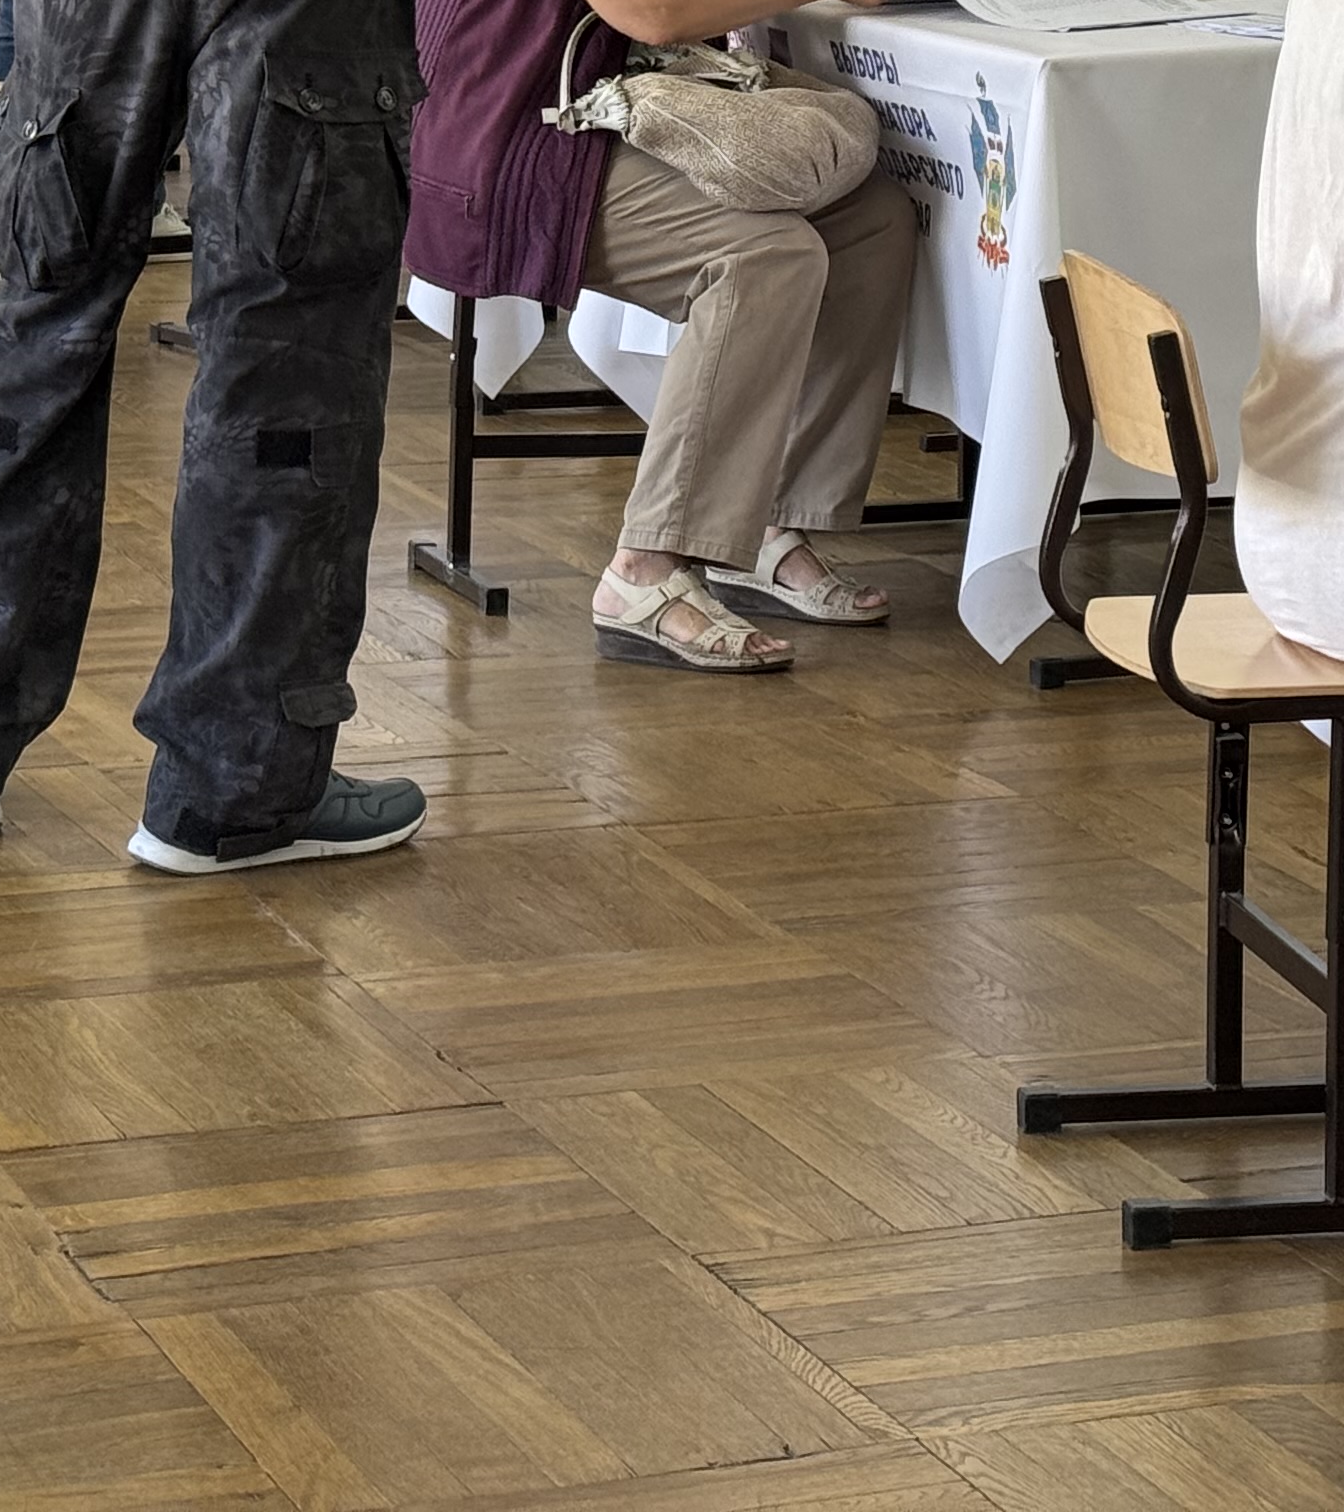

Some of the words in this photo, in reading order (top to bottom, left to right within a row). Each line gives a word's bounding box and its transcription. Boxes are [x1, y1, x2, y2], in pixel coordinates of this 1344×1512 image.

[829, 40, 901, 87] ВЫБОРЫ
[867, 97, 938, 143] НАТОРА
[877, 145, 964, 201] ОДАРСКОГО
